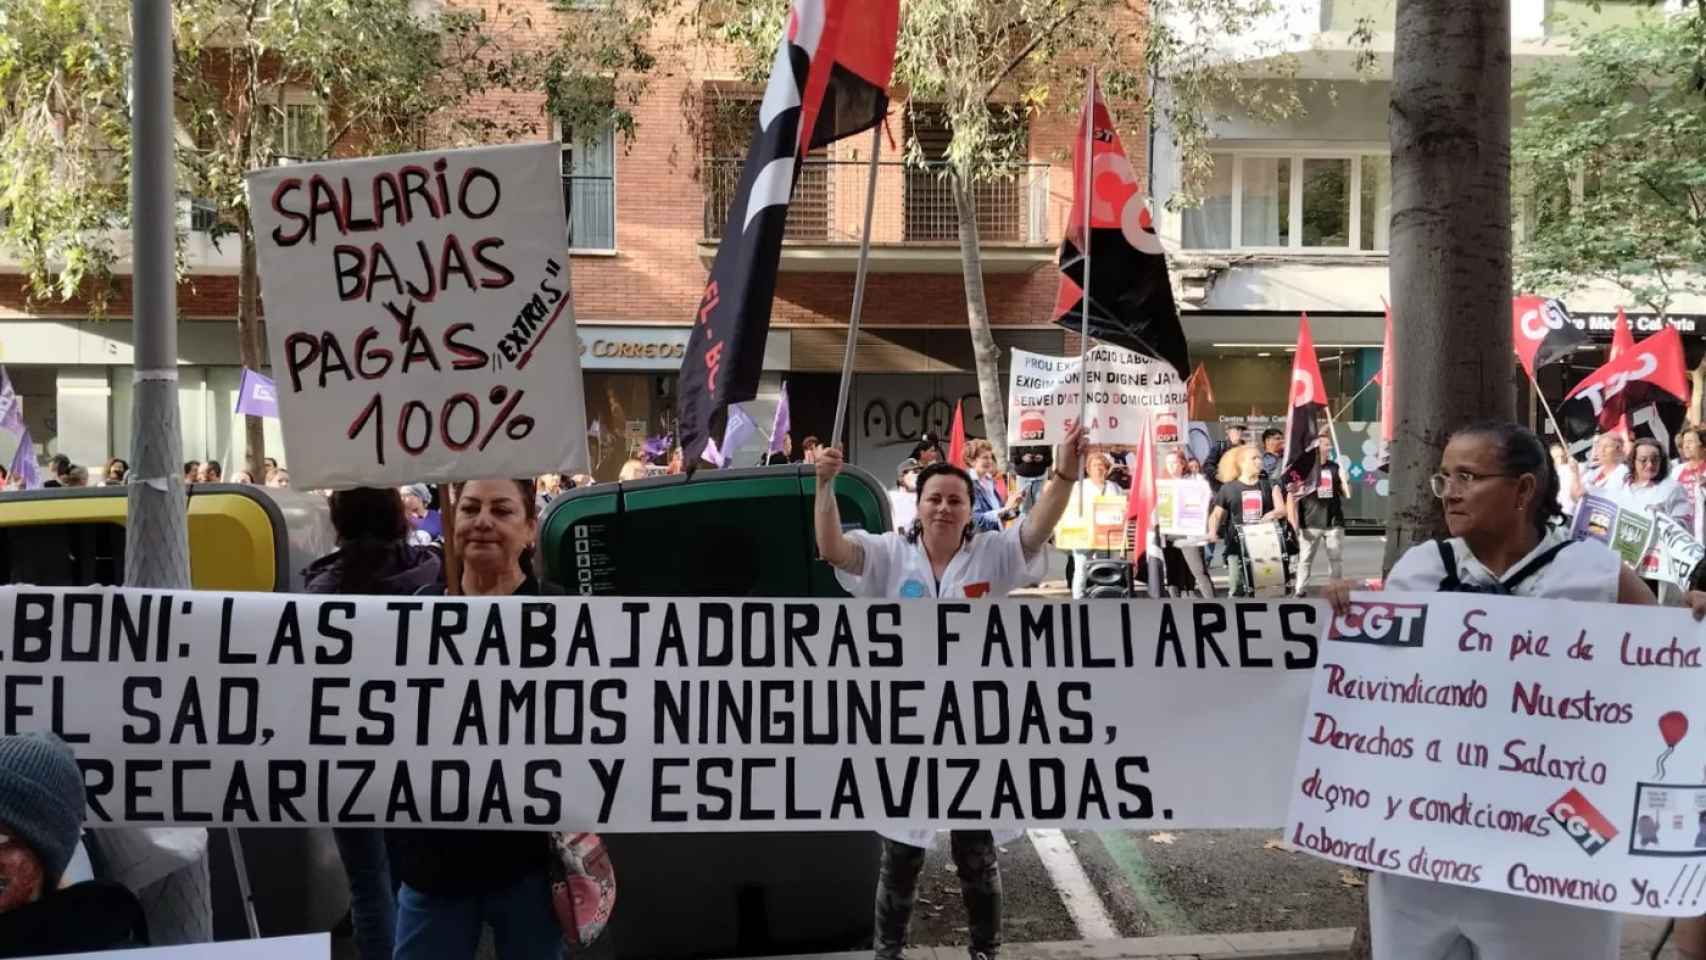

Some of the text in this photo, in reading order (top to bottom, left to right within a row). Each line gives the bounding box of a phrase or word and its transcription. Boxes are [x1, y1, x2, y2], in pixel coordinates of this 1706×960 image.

[333, 233, 515, 302] BAJAS
[382, 299, 416, 344] Y
[284, 323, 489, 393] PAGAS
[1106, 371, 1148, 386] DIGNE
[346, 384, 536, 466] 100%
[0, 593, 1319, 670] BONI: LAS TRABAJADORAS FAMILIARES
[1334, 604, 1423, 644] CGT
[1458, 608, 1494, 654] En
[1508, 629, 1552, 663] pie
[1566, 629, 1595, 662] de
[122, 675, 275, 746] SAD,
[308, 677, 628, 746] ESTAMOS
[653, 680, 1118, 746] NINGUNEADAS,
[1323, 663, 1634, 725] Reivindicando Nuestros
[1307, 712, 1608, 786] Derechos a un Salario
[80, 755, 1174, 826] RECARIZADAS Y ESCLAVIZADAS.
[1300, 767, 1552, 839] digno y condiciones
[1551, 802, 1607, 853] CGT
[1292, 821, 1402, 872] Laborales
[1407, 846, 1484, 885] dignas
[1506, 862, 1618, 905] Convenio
